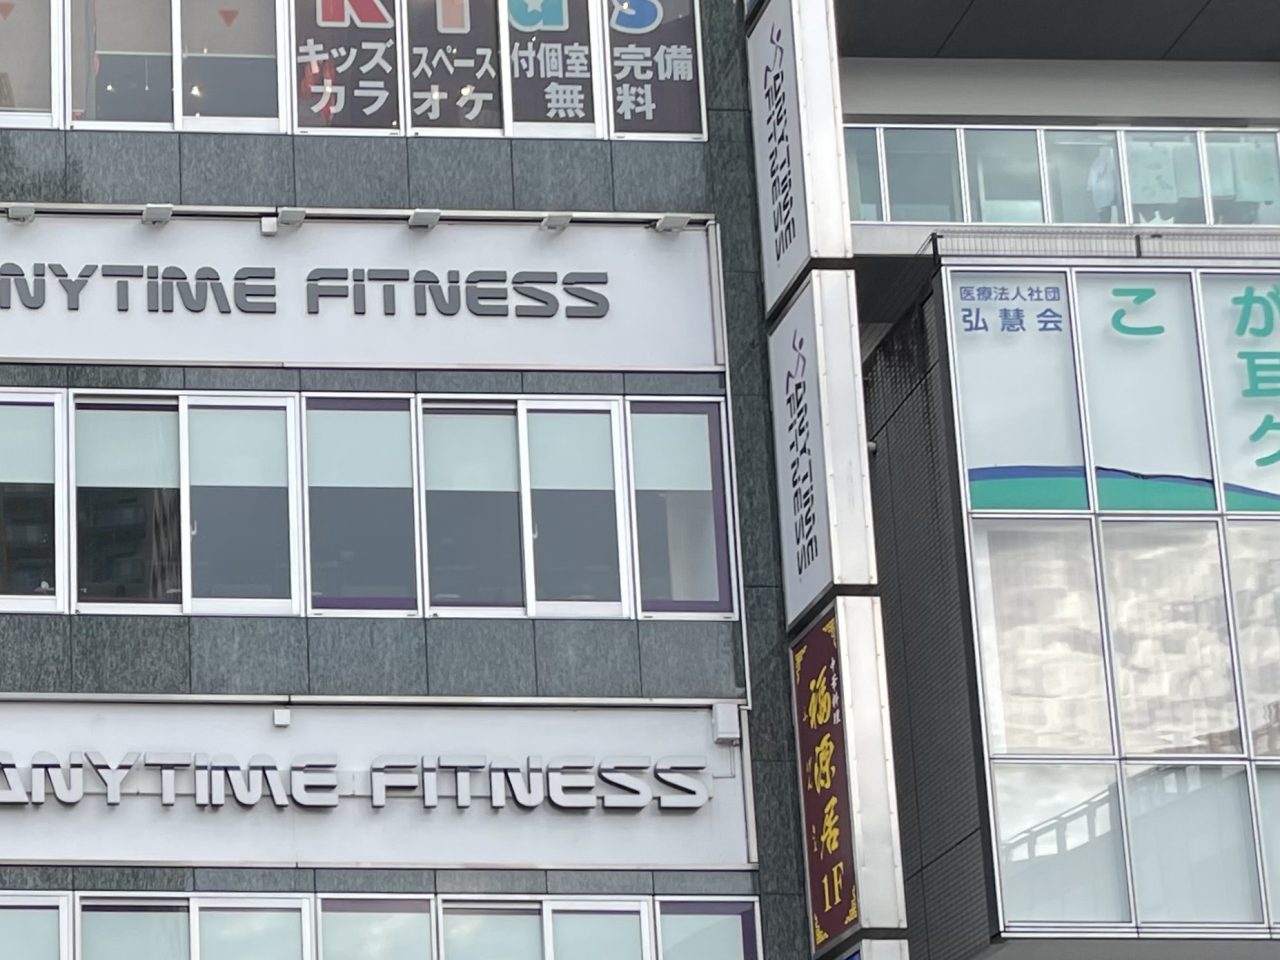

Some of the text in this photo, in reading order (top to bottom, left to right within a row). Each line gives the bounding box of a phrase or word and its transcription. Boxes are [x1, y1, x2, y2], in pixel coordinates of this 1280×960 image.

[764, 87, 785, 262] FITNESS
[772, 71, 796, 247] ANYTIME
[307, 267, 610, 319] FITNESS
[960, 286, 1060, 301] 医療法人社団
[961, 308, 1062, 332] 弘慧会
[786, 395, 805, 576] FITNESS
[794, 381, 818, 559] ANYTIME
[371, 753, 712, 811] FITNESS
[821, 862, 845, 912] 1F
